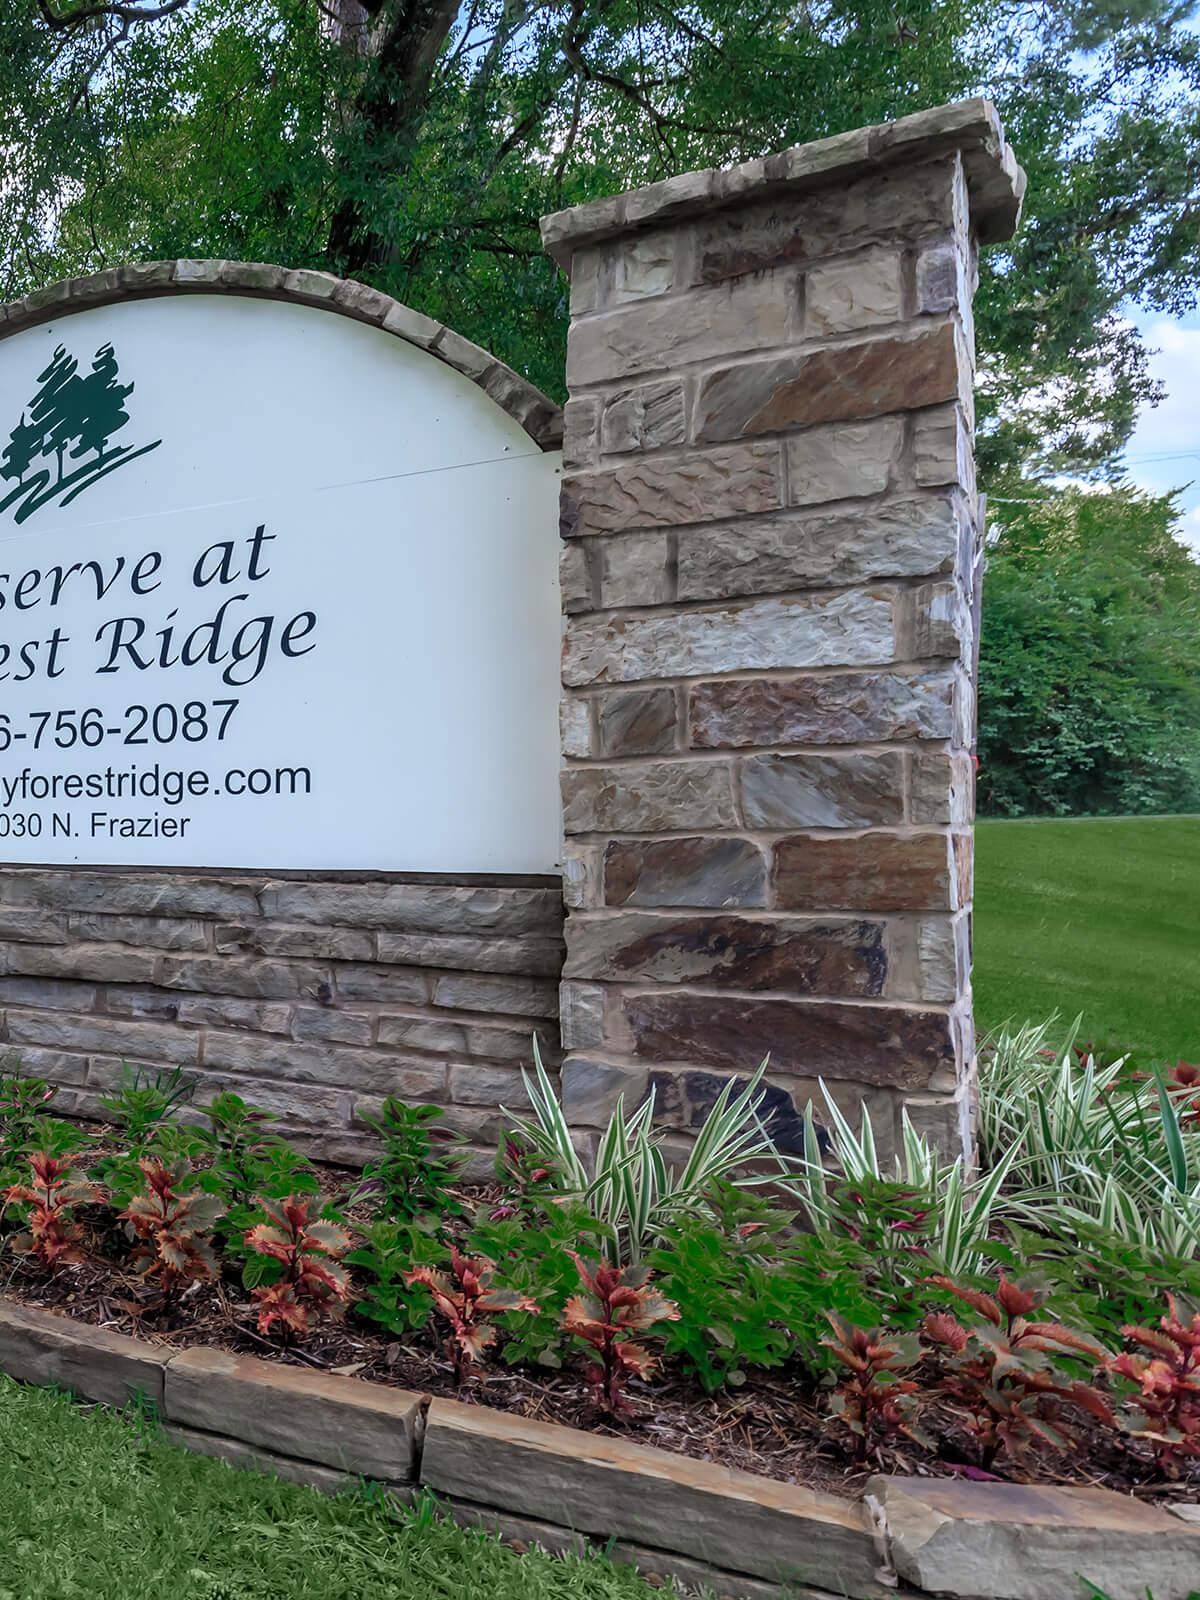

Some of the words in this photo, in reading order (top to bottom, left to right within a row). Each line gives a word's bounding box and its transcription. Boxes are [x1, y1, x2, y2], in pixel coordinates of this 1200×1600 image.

[192, 523, 277, 588] at
[94, 593, 317, 687] Ridge
[52, 812, 79, 838] N.
[91, 811, 191, 838] Frazier
